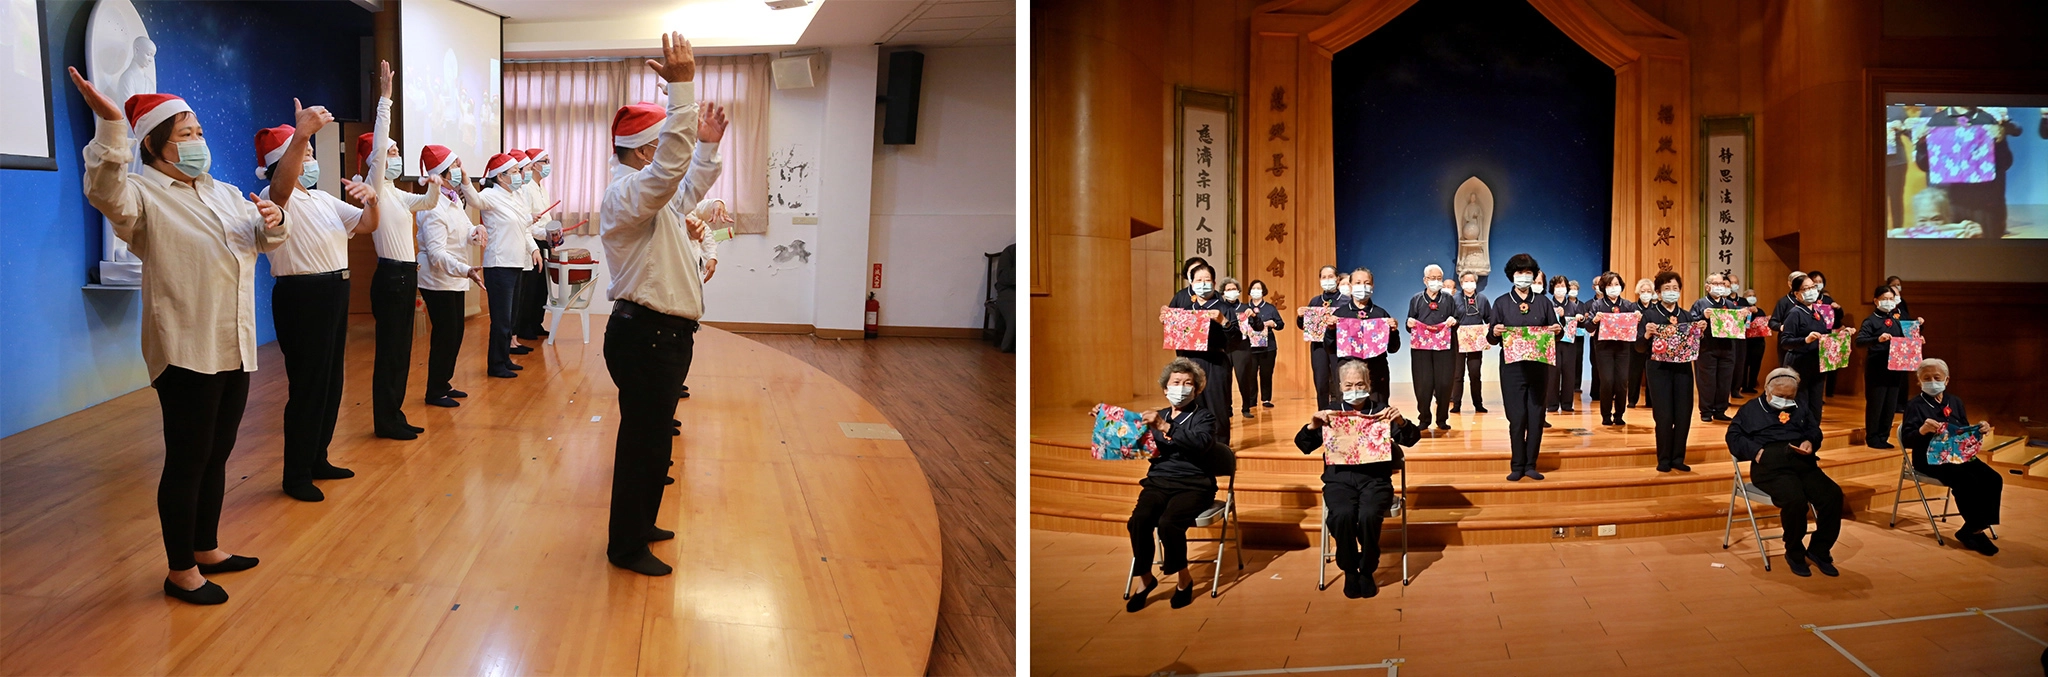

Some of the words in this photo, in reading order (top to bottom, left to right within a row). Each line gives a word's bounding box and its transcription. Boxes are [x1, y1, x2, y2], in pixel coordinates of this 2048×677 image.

[1196, 124, 1213, 257] 慈濟宗門人間
